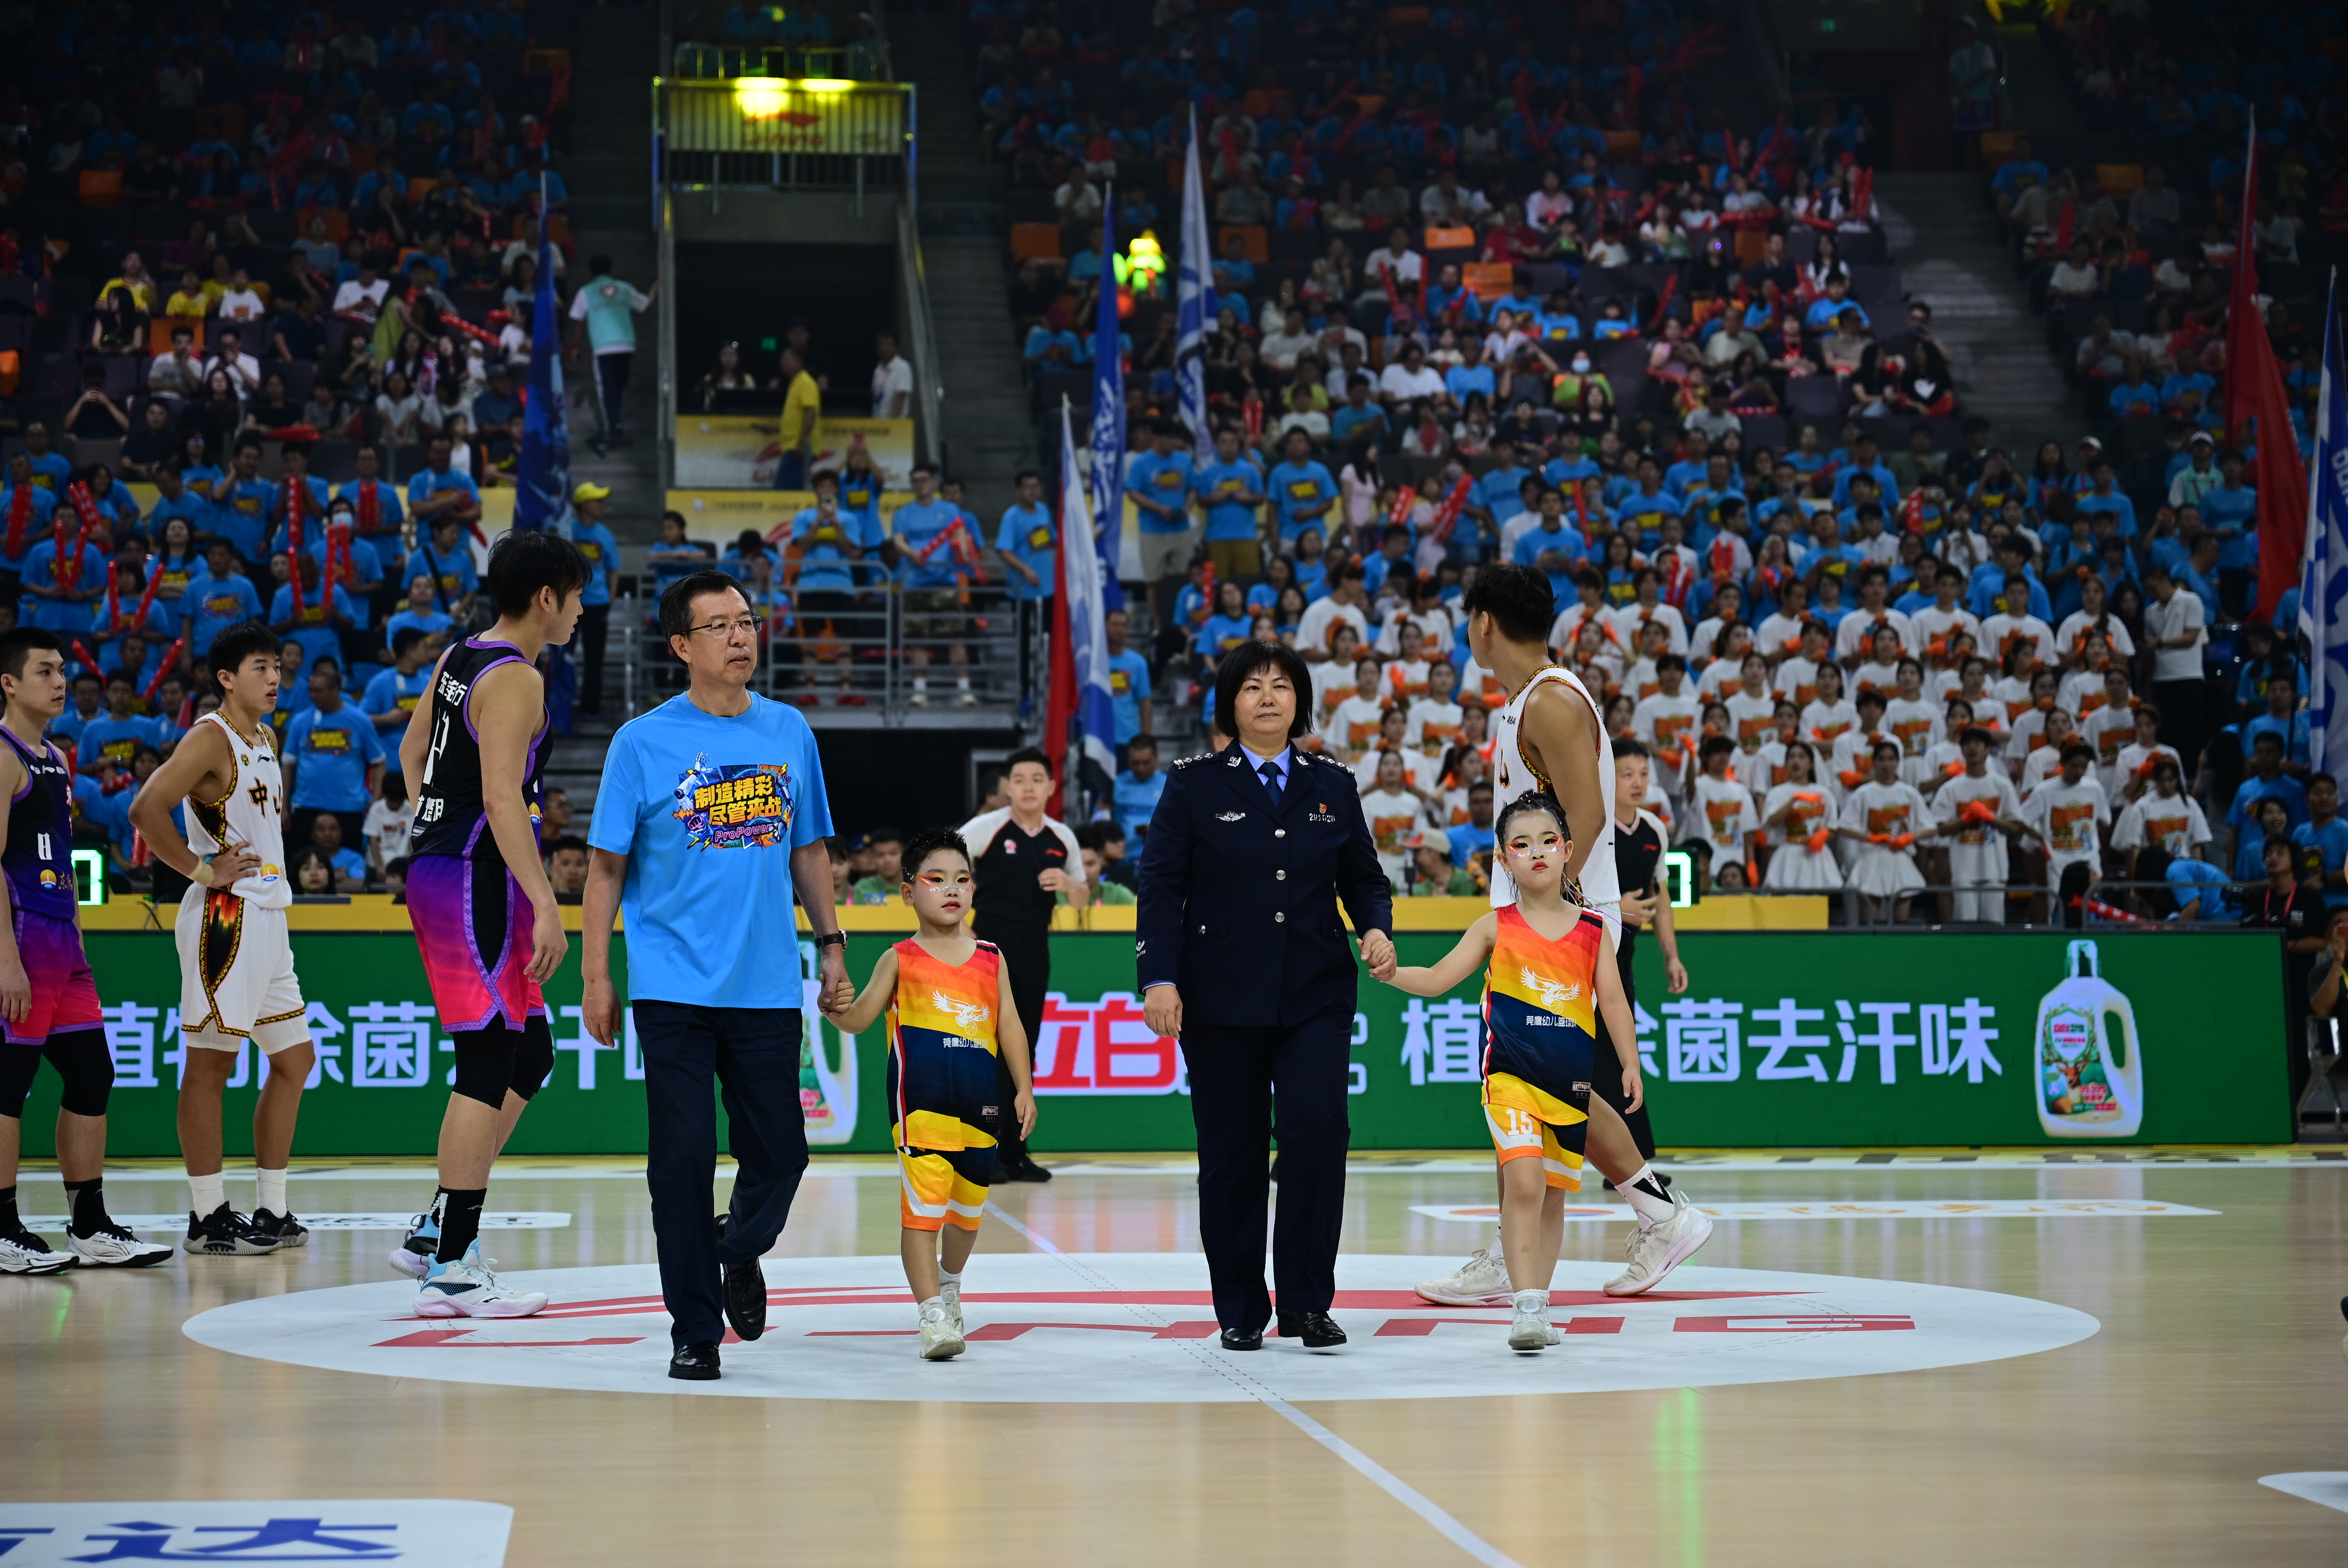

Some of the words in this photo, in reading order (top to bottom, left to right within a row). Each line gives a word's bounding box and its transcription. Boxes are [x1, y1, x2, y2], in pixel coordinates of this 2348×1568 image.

[694, 775, 774, 810] 制造精彩
[708, 796, 782, 827] 尽管来战
[714, 823, 773, 843] ProPower
[1136, 949, 1146, 960] OLICE
[1526, 1015, 1577, 1028] 莞鹰幼儿篮球队
[1401, 997, 2003, 1086] 植菌去汗味
[1506, 1109, 1533, 1137] 15
